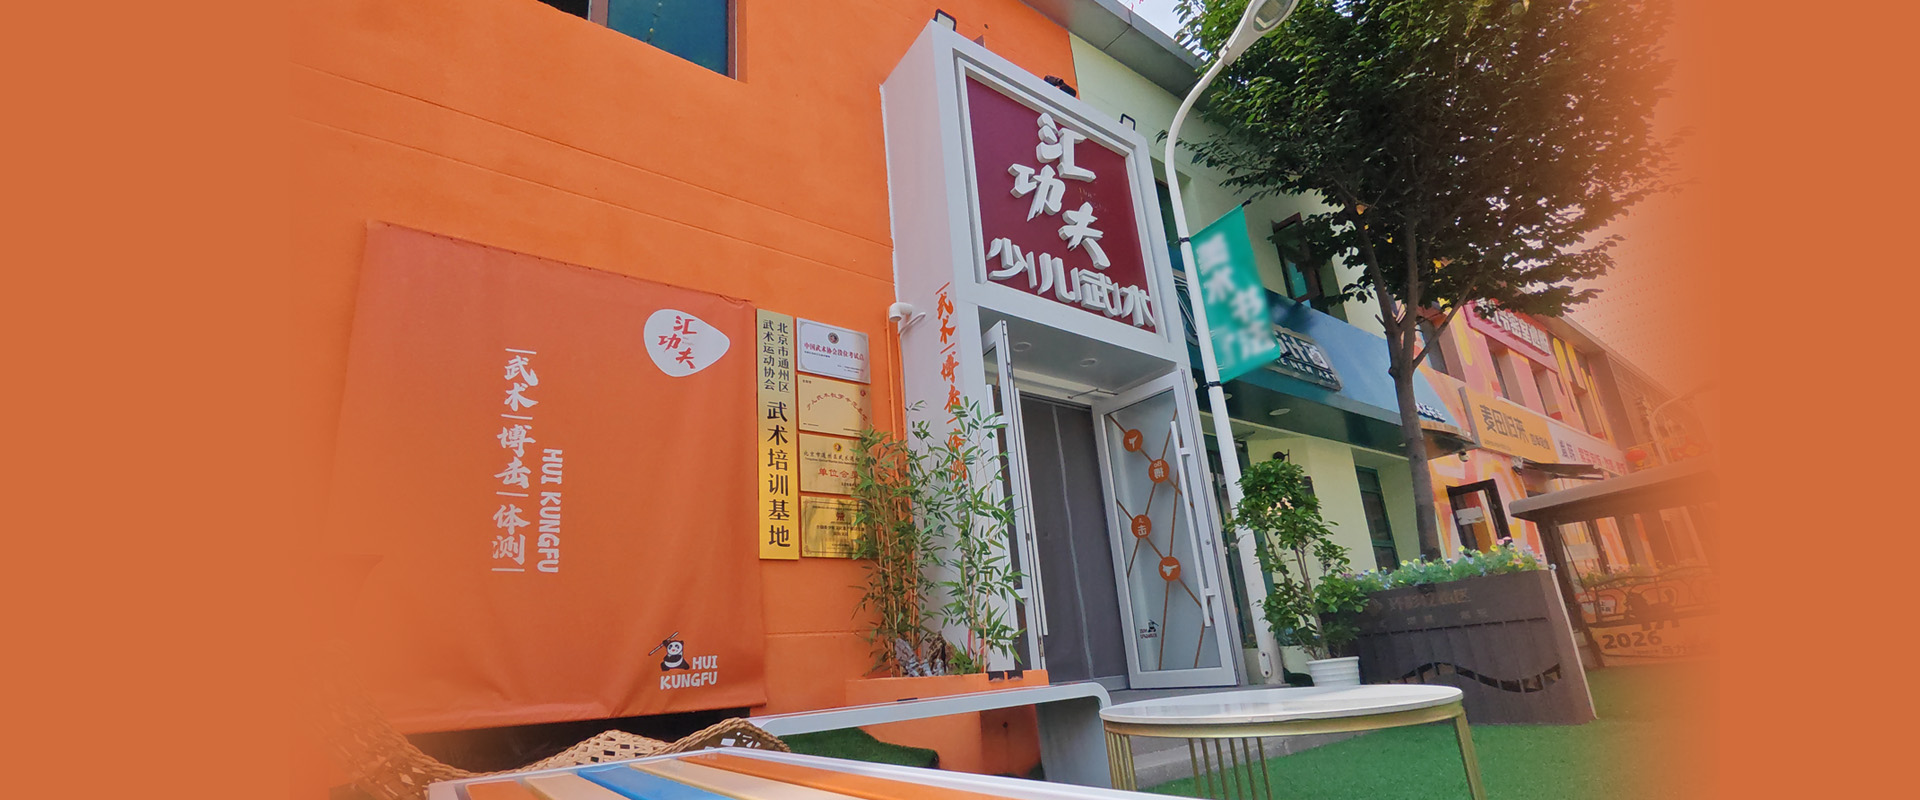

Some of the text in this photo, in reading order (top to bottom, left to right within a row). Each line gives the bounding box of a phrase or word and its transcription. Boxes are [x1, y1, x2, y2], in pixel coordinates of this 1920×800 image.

[1008, 112, 1110, 268] 汇功夫
[658, 315, 697, 369] 汇功夫
[762, 320, 775, 391] 武术运动协会
[777, 322, 790, 393] 北京市通州区
[504, 355, 539, 412] 武术
[766, 401, 792, 548] 武术培训基地
[491, 503, 531, 565] 体测
[537, 448, 563, 573] HUI KUNGFU
[692, 655, 718, 670] HUI
[1602, 630, 1662, 649] 2026
[660, 671, 718, 690] KUNGFU
